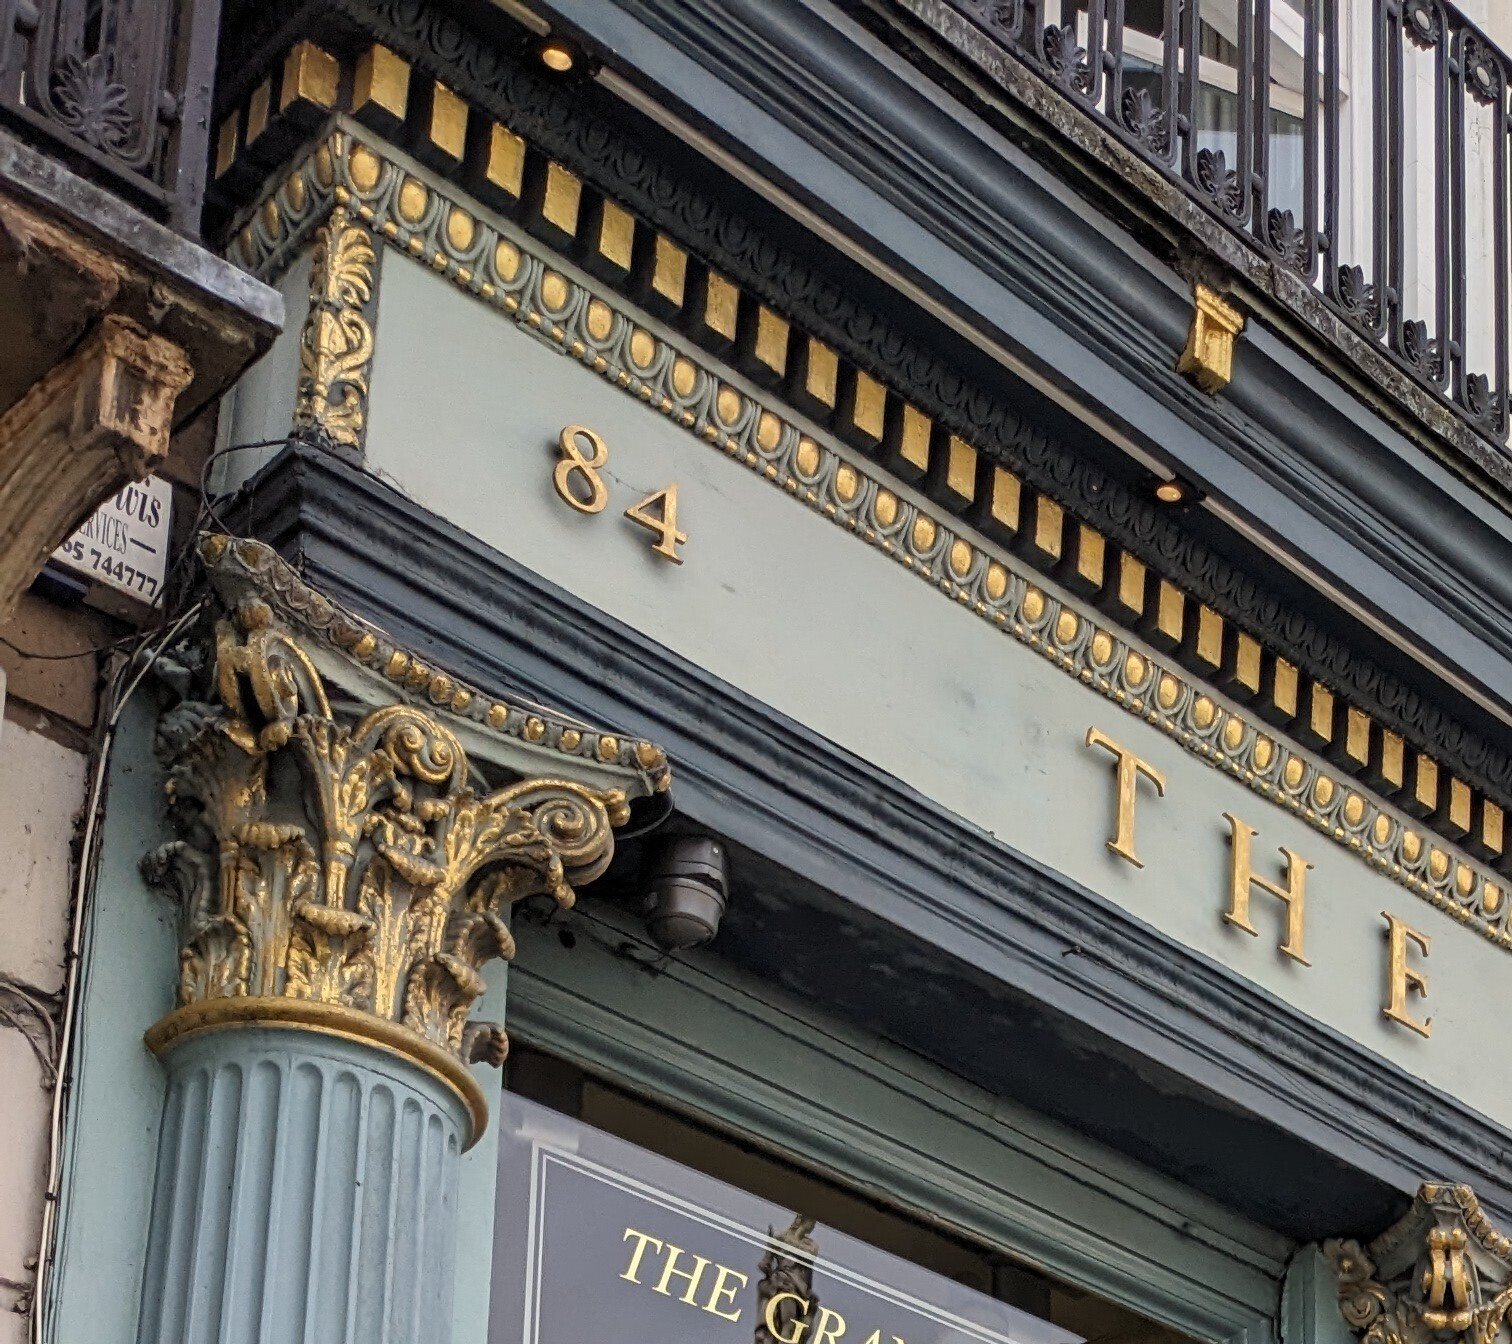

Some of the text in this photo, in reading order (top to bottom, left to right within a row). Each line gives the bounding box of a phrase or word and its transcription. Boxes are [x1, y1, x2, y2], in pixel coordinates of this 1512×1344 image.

[91, 548, 158, 597] 744777
[553, 424, 689, 566] 84
[1085, 725, 1433, 1039] THE
[620, 1229, 748, 1323] THE
